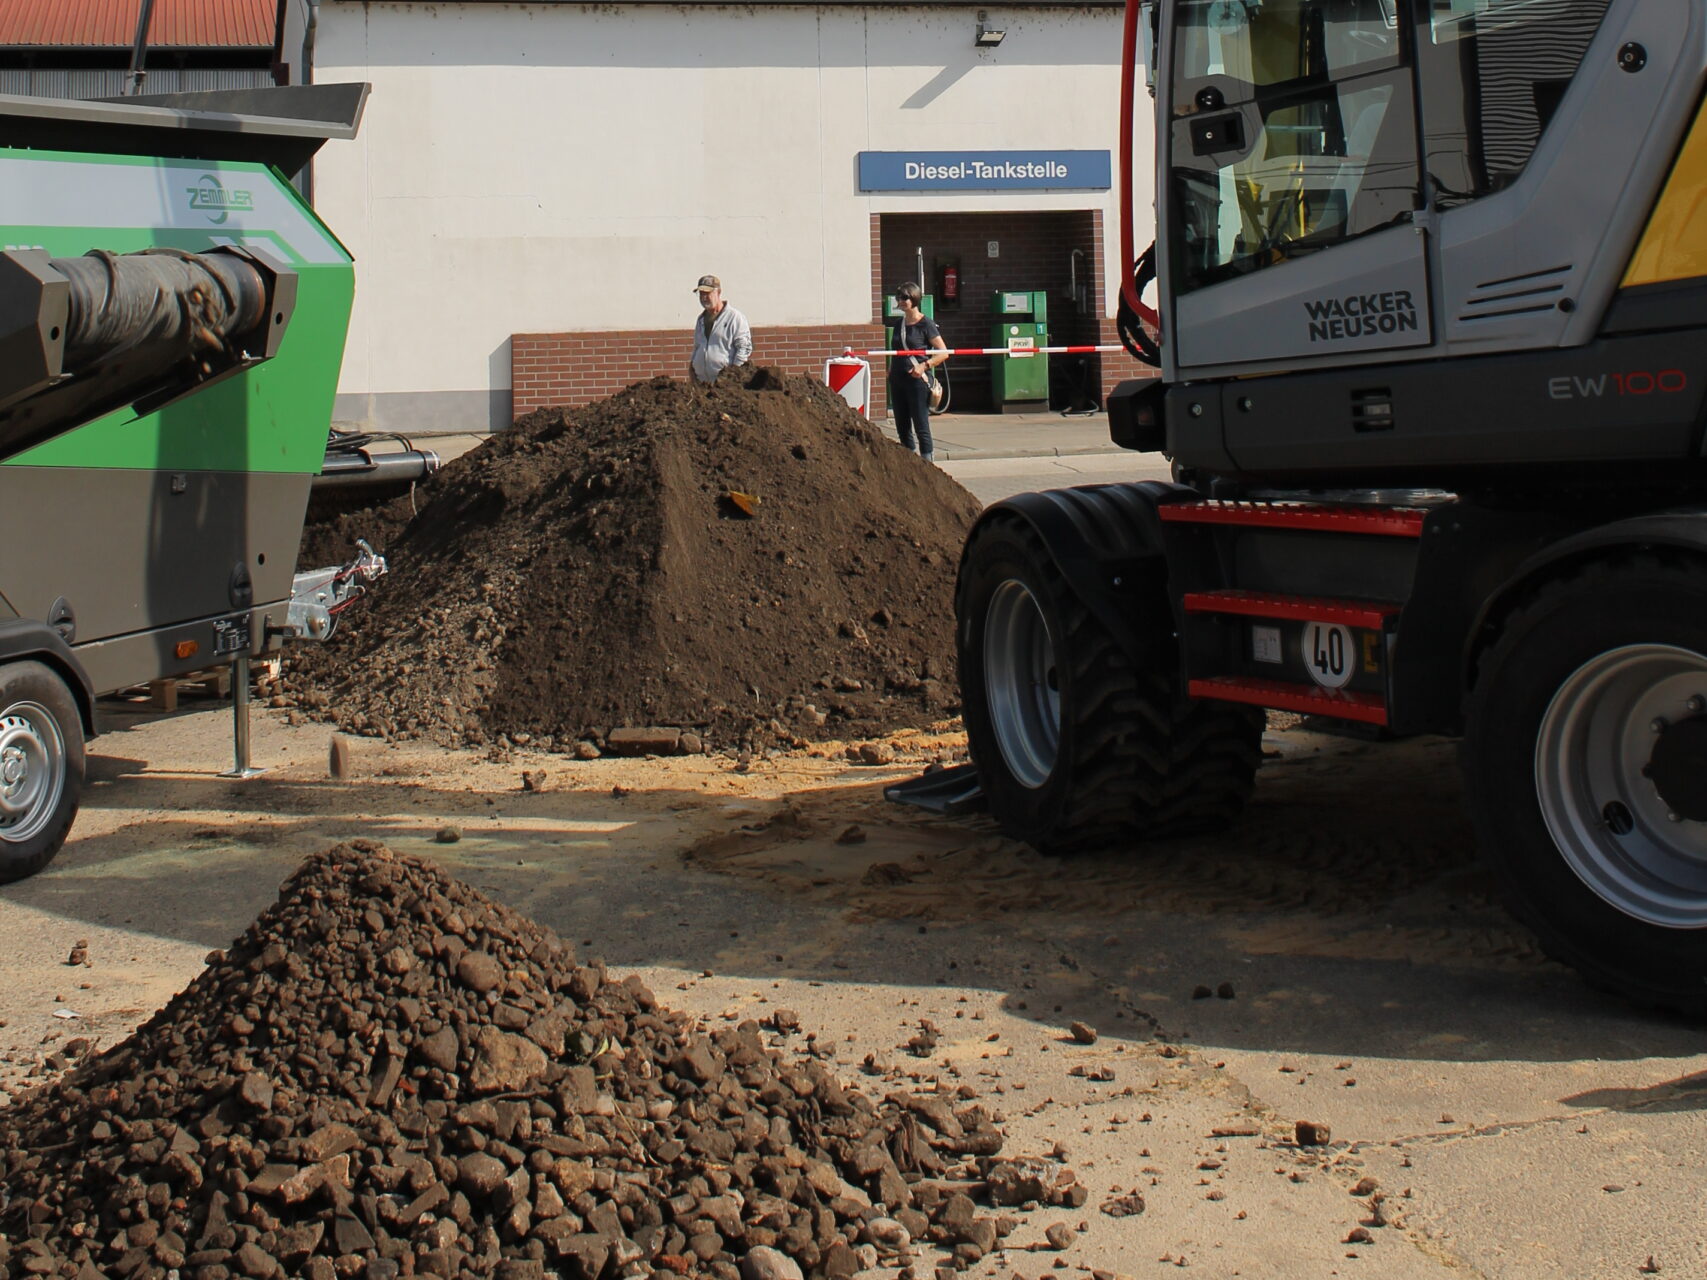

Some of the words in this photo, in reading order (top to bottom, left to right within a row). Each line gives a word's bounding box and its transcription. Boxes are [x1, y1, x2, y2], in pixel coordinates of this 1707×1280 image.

[904, 161, 1068, 180] Diesel-Tankstelle
[186, 187, 254, 211] ZEMMLER
[1303, 290, 1415, 320] WACKER
[1308, 310, 1418, 341] NEUSON
[1548, 369, 1687, 399] EW100
[1312, 625, 1345, 675] 40
